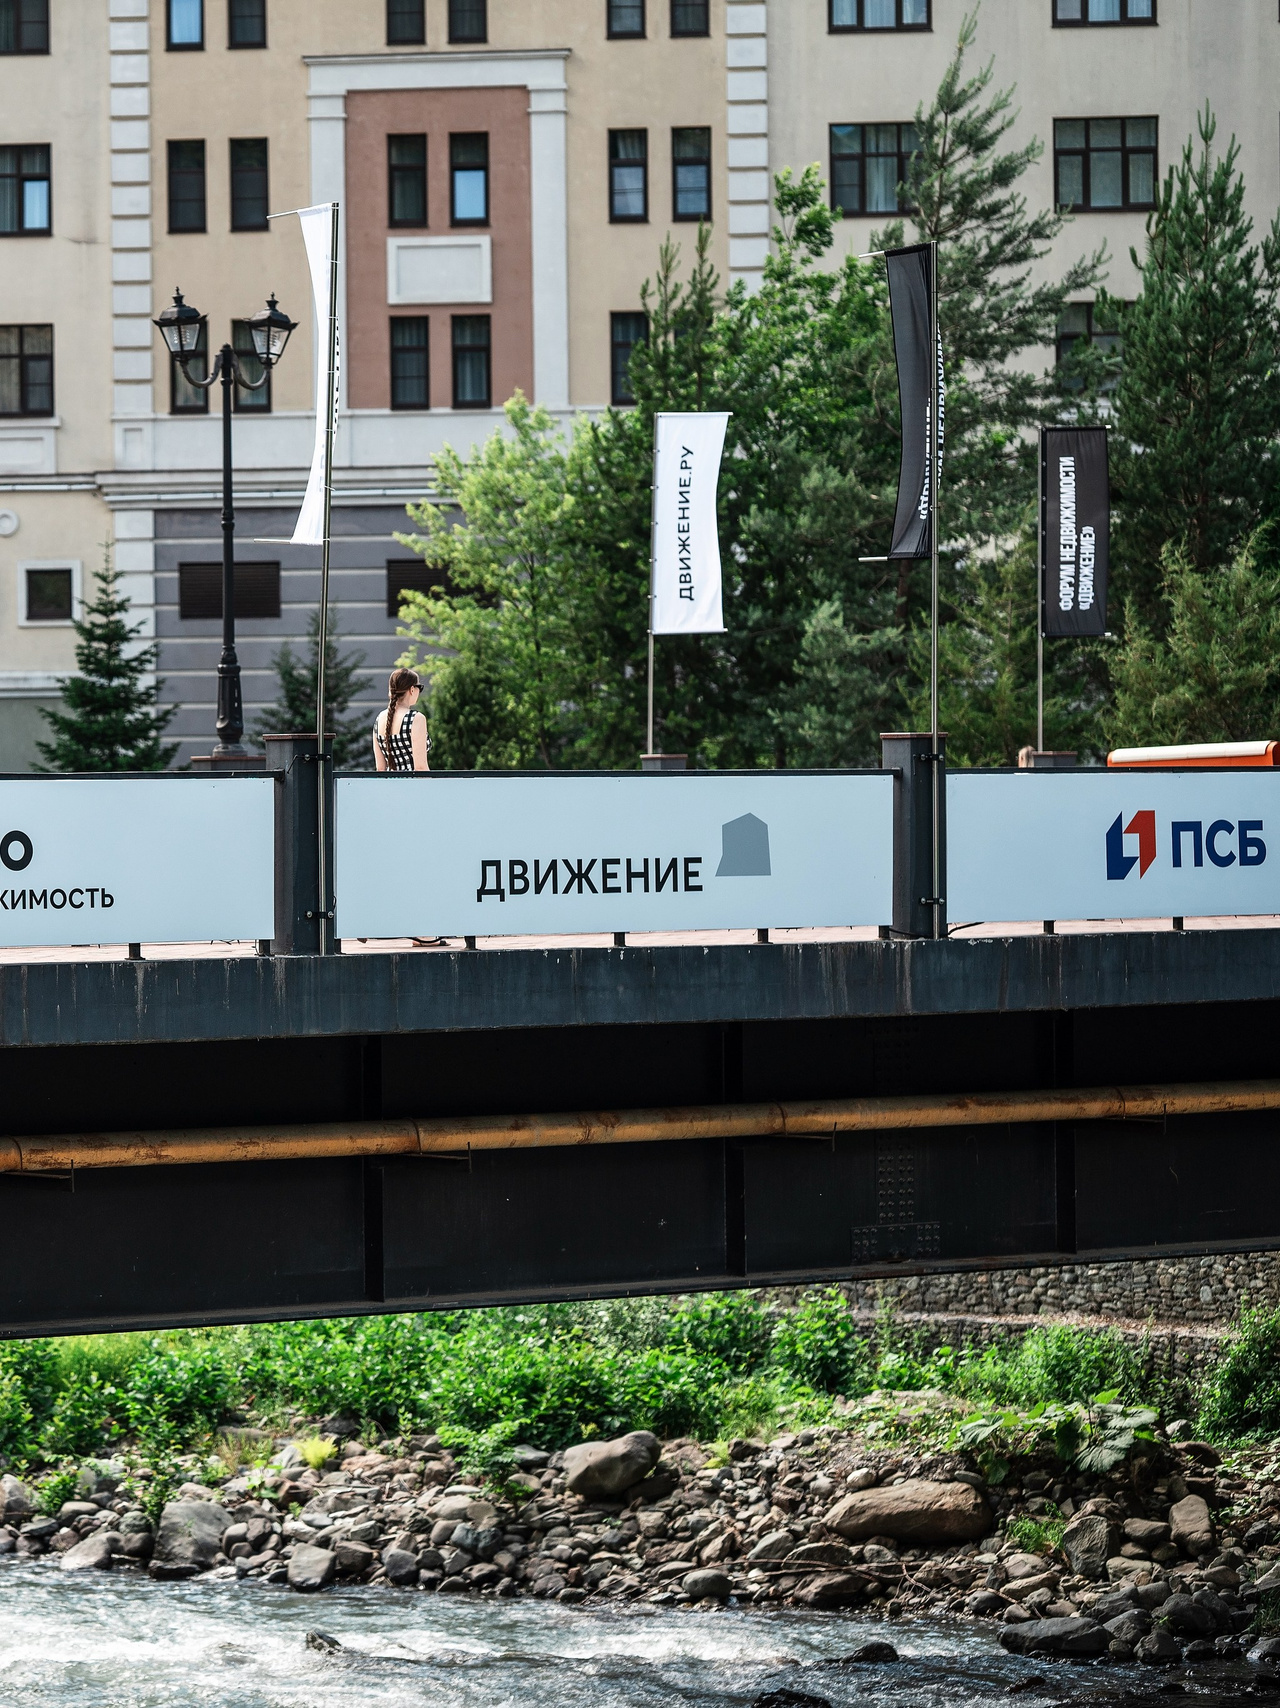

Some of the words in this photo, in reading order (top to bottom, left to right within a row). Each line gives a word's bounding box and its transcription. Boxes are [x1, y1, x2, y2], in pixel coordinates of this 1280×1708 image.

[678, 446, 694, 601] ДВИЖЕНИЕ.РУ
[1059, 456, 1077, 562] НЕДВИЖИМОСТИ
[1059, 563, 1075, 611] ФОРУМ
[1078, 526, 1095, 610] «ДВИЖЕНИЕ»
[1171, 819, 1267, 868] ПСБ
[476, 857, 703, 902] ДВИЖЕНИЕ
